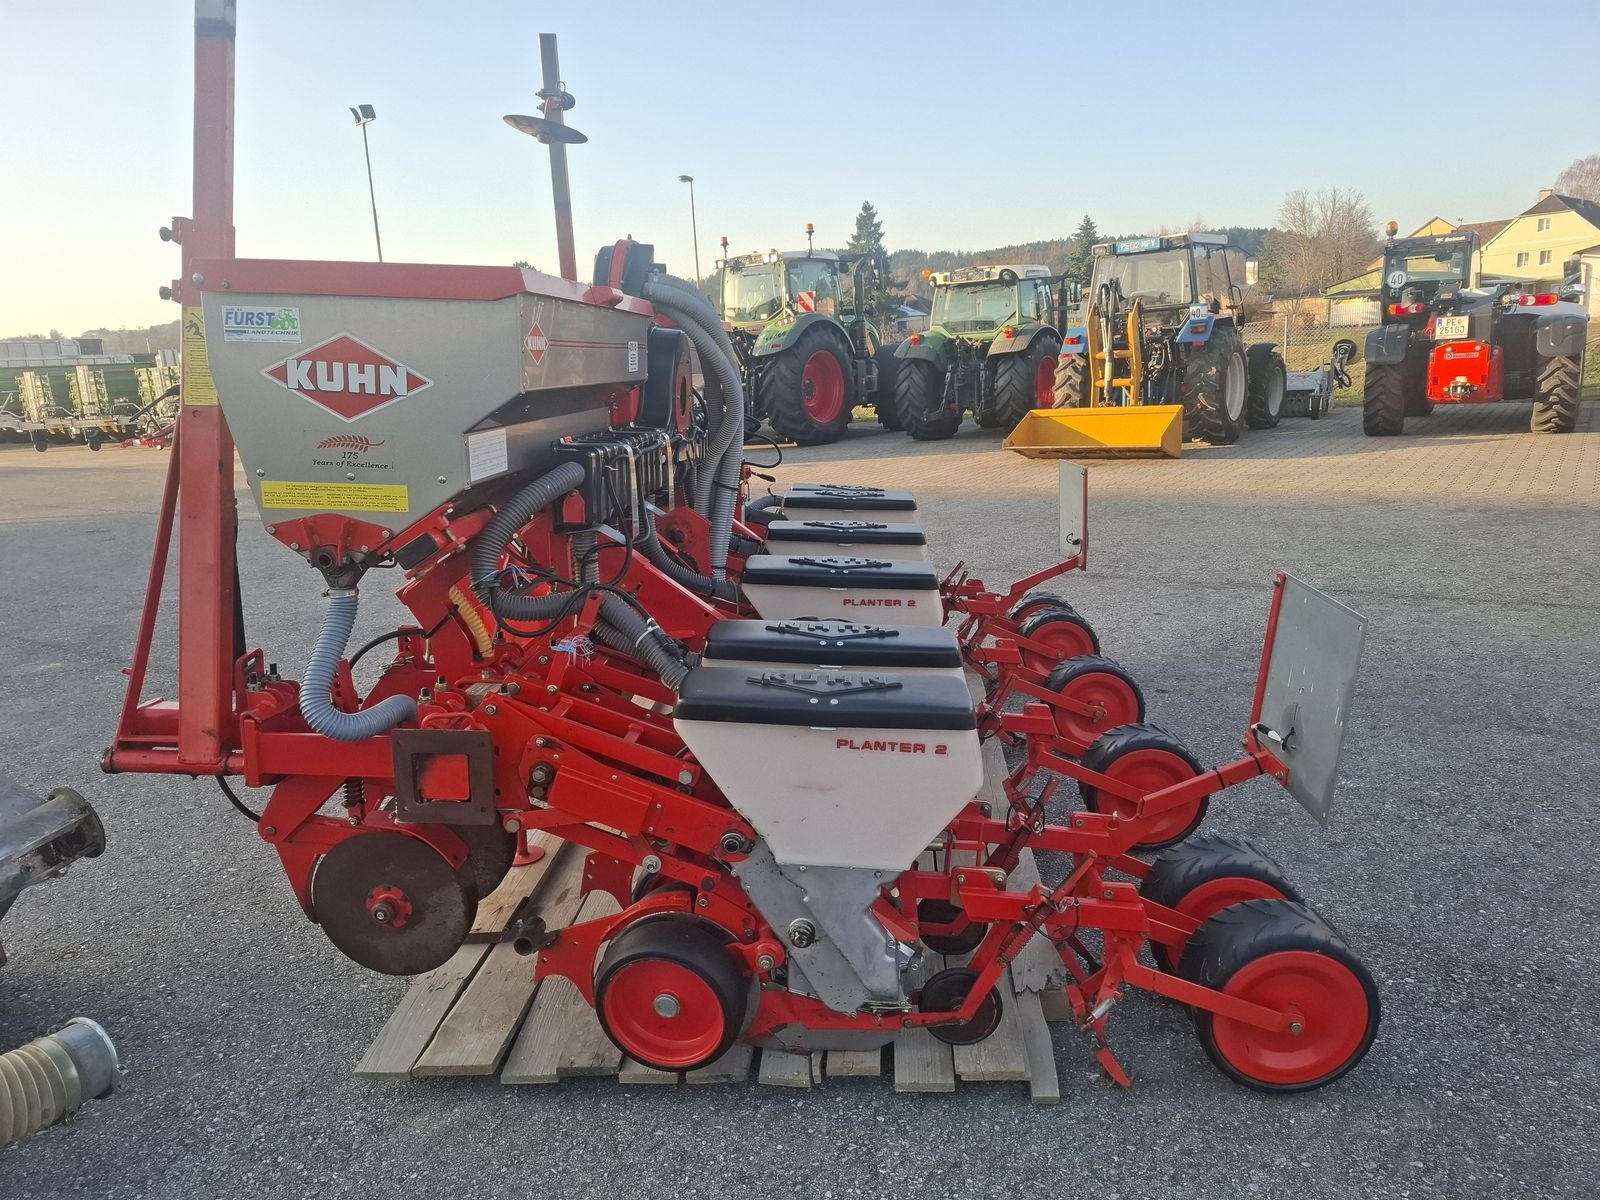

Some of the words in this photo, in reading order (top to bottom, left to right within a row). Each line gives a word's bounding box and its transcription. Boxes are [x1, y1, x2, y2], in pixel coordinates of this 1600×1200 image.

[1391, 273, 1403, 285] 40
[1191, 307, 1201, 319] 40
[1446, 318, 1457, 327] PE
[1439, 325, 1465, 335] 251GJ
[286, 359, 408, 396] KUHN
[341, 451, 359, 459] 175
[312, 459, 334, 467] Years
[336, 460, 346, 469] of
[346, 460, 389, 470] Excellence
[842, 598, 901, 607] PLANTER
[907, 599, 917, 608] 2
[836, 738, 926, 754] PLANTER
[934, 744, 948, 755] 2
